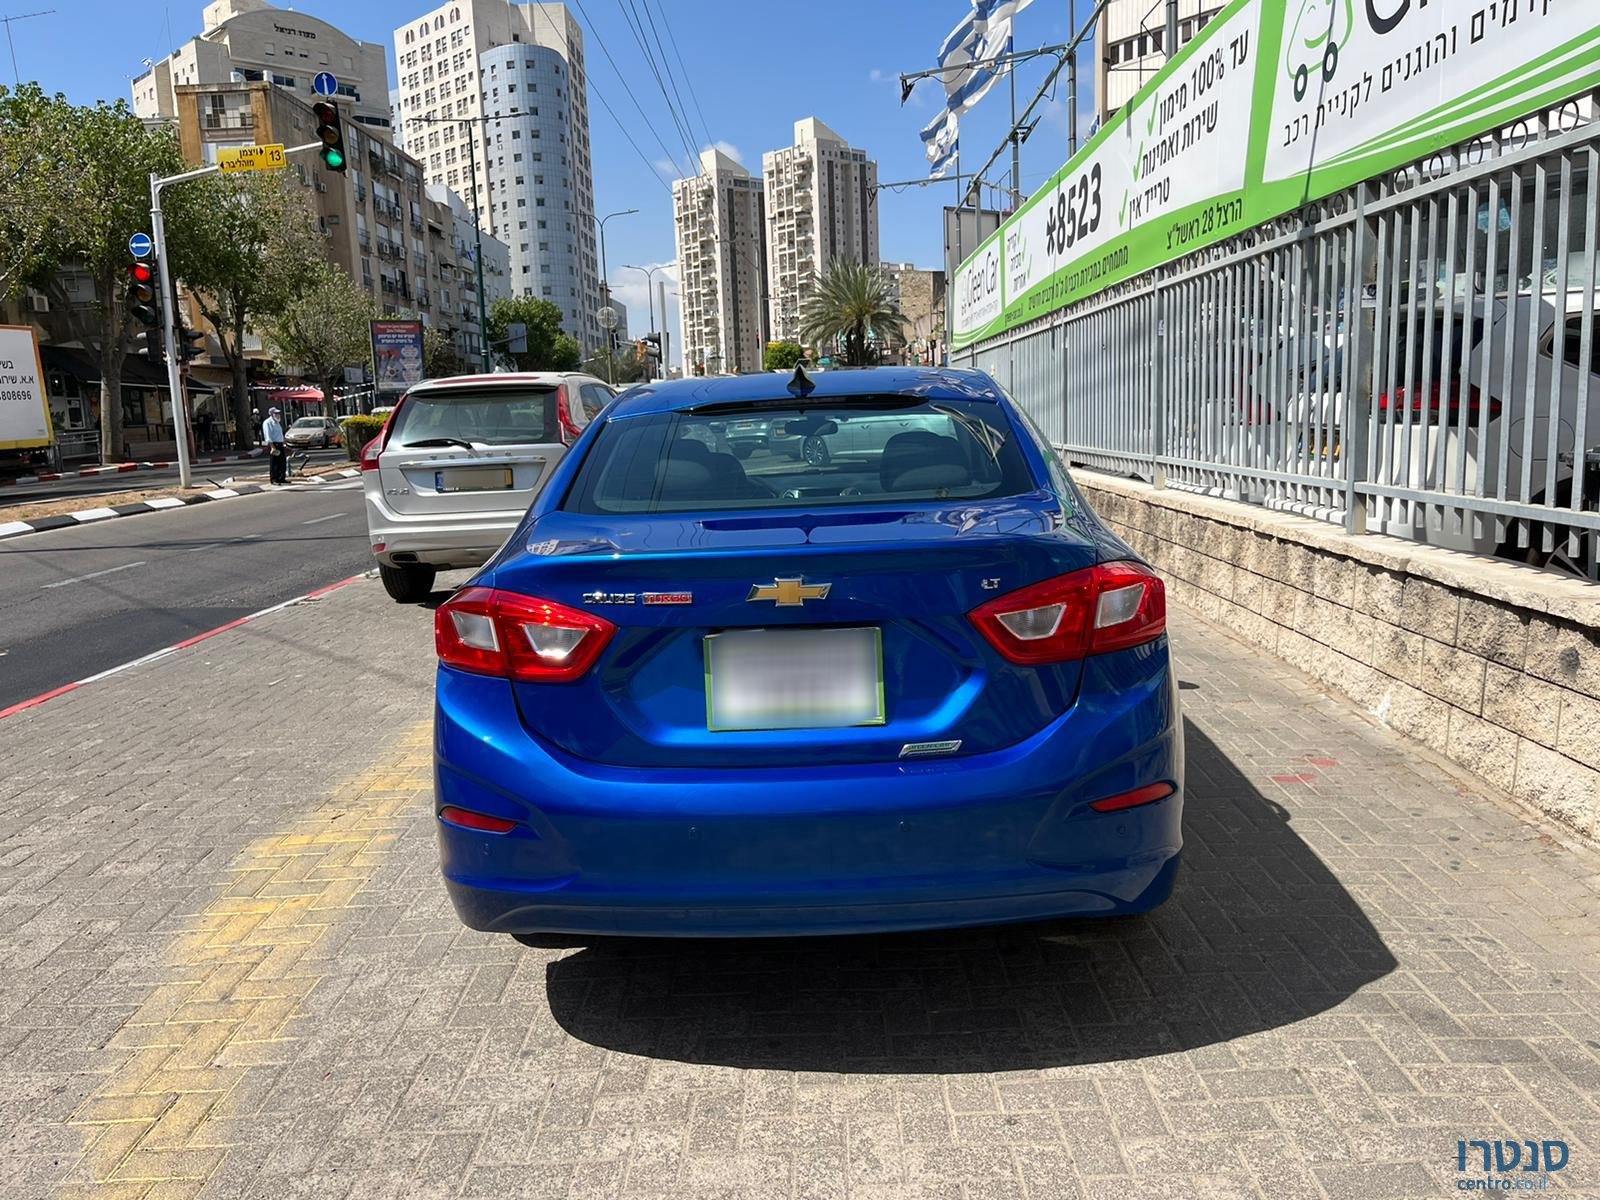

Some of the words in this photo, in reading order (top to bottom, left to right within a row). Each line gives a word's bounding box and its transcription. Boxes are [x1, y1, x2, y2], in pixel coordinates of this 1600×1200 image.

[1229, 29, 1249, 70] עד
[1381, 26, 1457, 93] והוגנים
[1191, 47, 1225, 101] 100%
[1158, 83, 1187, 135] מימון
[1315, 71, 1373, 130] לקניית
[1181, 100, 1219, 148] שירות
[1283, 114, 1308, 147] רכב
[226, 158, 255, 168] מוהליבר
[240, 147, 259, 159] ויצמן
[269, 149, 282, 161] 13
[1142, 128, 1179, 179] ואמינות
[1129, 193, 1142, 230] אין
[1145, 176, 1170, 213] טרייד
[1216, 198, 1242, 228] הרצל
[1202, 207, 1214, 234] 28
[986, 251, 999, 295] Car
[1080, 261, 1101, 287] במכירת
[1102, 245, 1129, 276] מתמחים
[0, 376, 17, 384] שירו
[0, 390, 32, 400] 808696
